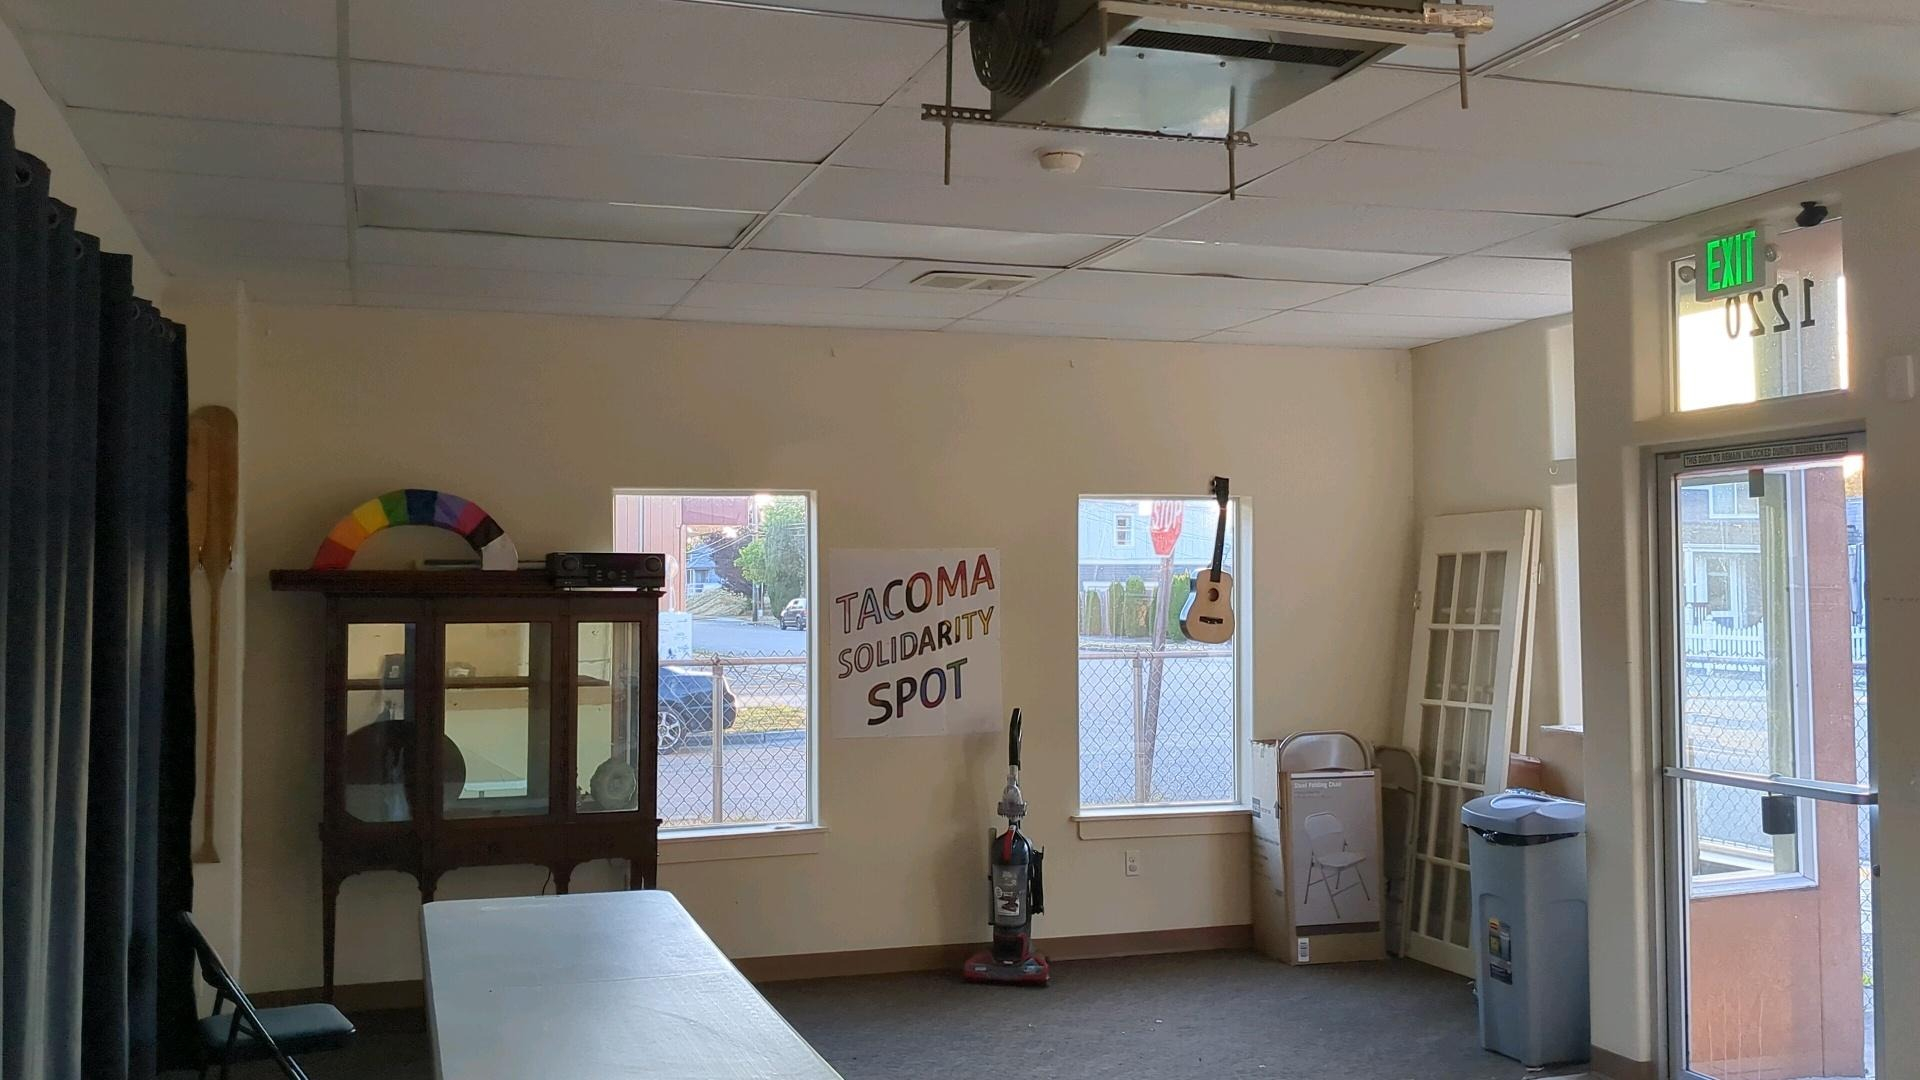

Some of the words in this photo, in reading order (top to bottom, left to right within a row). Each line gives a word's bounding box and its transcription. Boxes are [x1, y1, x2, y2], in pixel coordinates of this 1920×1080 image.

[1706, 229, 1757, 292] EXIT
[1686, 455, 1697, 466] THIS
[1698, 453, 1712, 465] DOOR
[1713, 452, 1721, 463] TO
[1721, 451, 1741, 463] REMAIN
[1742, 448, 1772, 460] UNLOCKED
[1773, 445, 1794, 457] DURING
[1152, 500, 1183, 531] STOP
[836, 553, 995, 634] TACOMA
[838, 606, 994, 679] SOLIDARITY
[867, 657, 968, 726] SPOT
